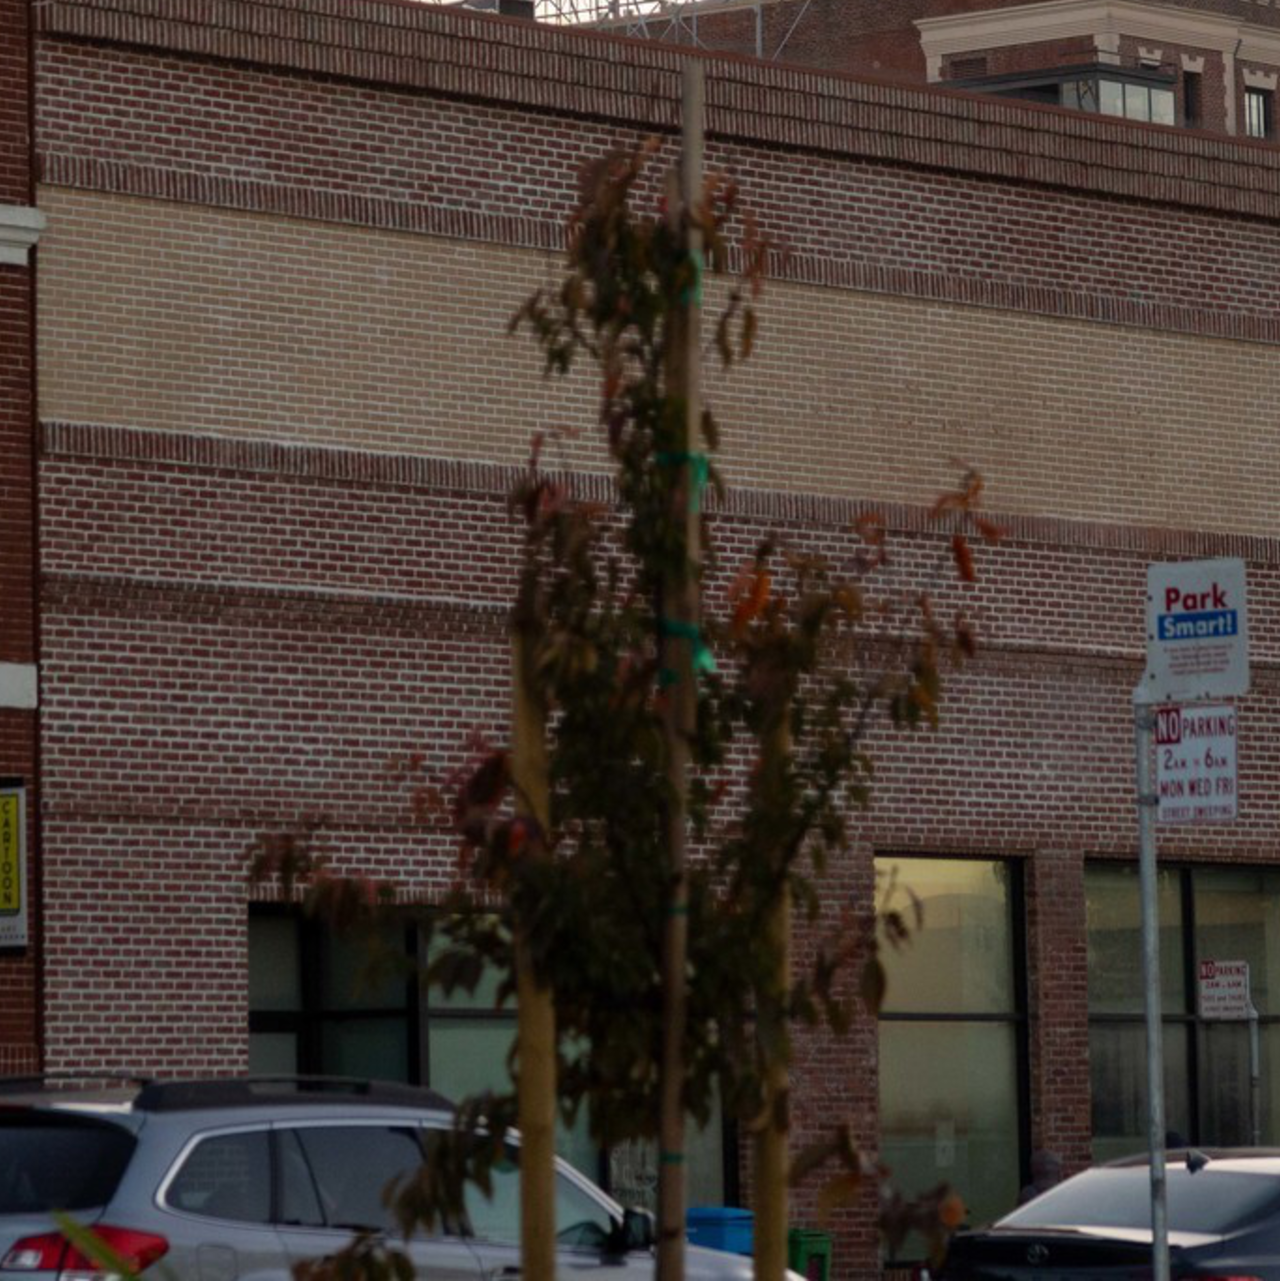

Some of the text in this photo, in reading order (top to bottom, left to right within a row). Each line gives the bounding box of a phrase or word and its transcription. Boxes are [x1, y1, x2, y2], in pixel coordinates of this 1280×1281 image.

[1165, 582, 1227, 612] Park
[1163, 614, 1233, 638] Smart!
[1157, 711, 1235, 741] NO PARKING
[1160, 777, 1234, 797] MON WED FRI
[1, 801, 13, 904] CARTOON
[1214, 965, 1247, 977] PARKING
